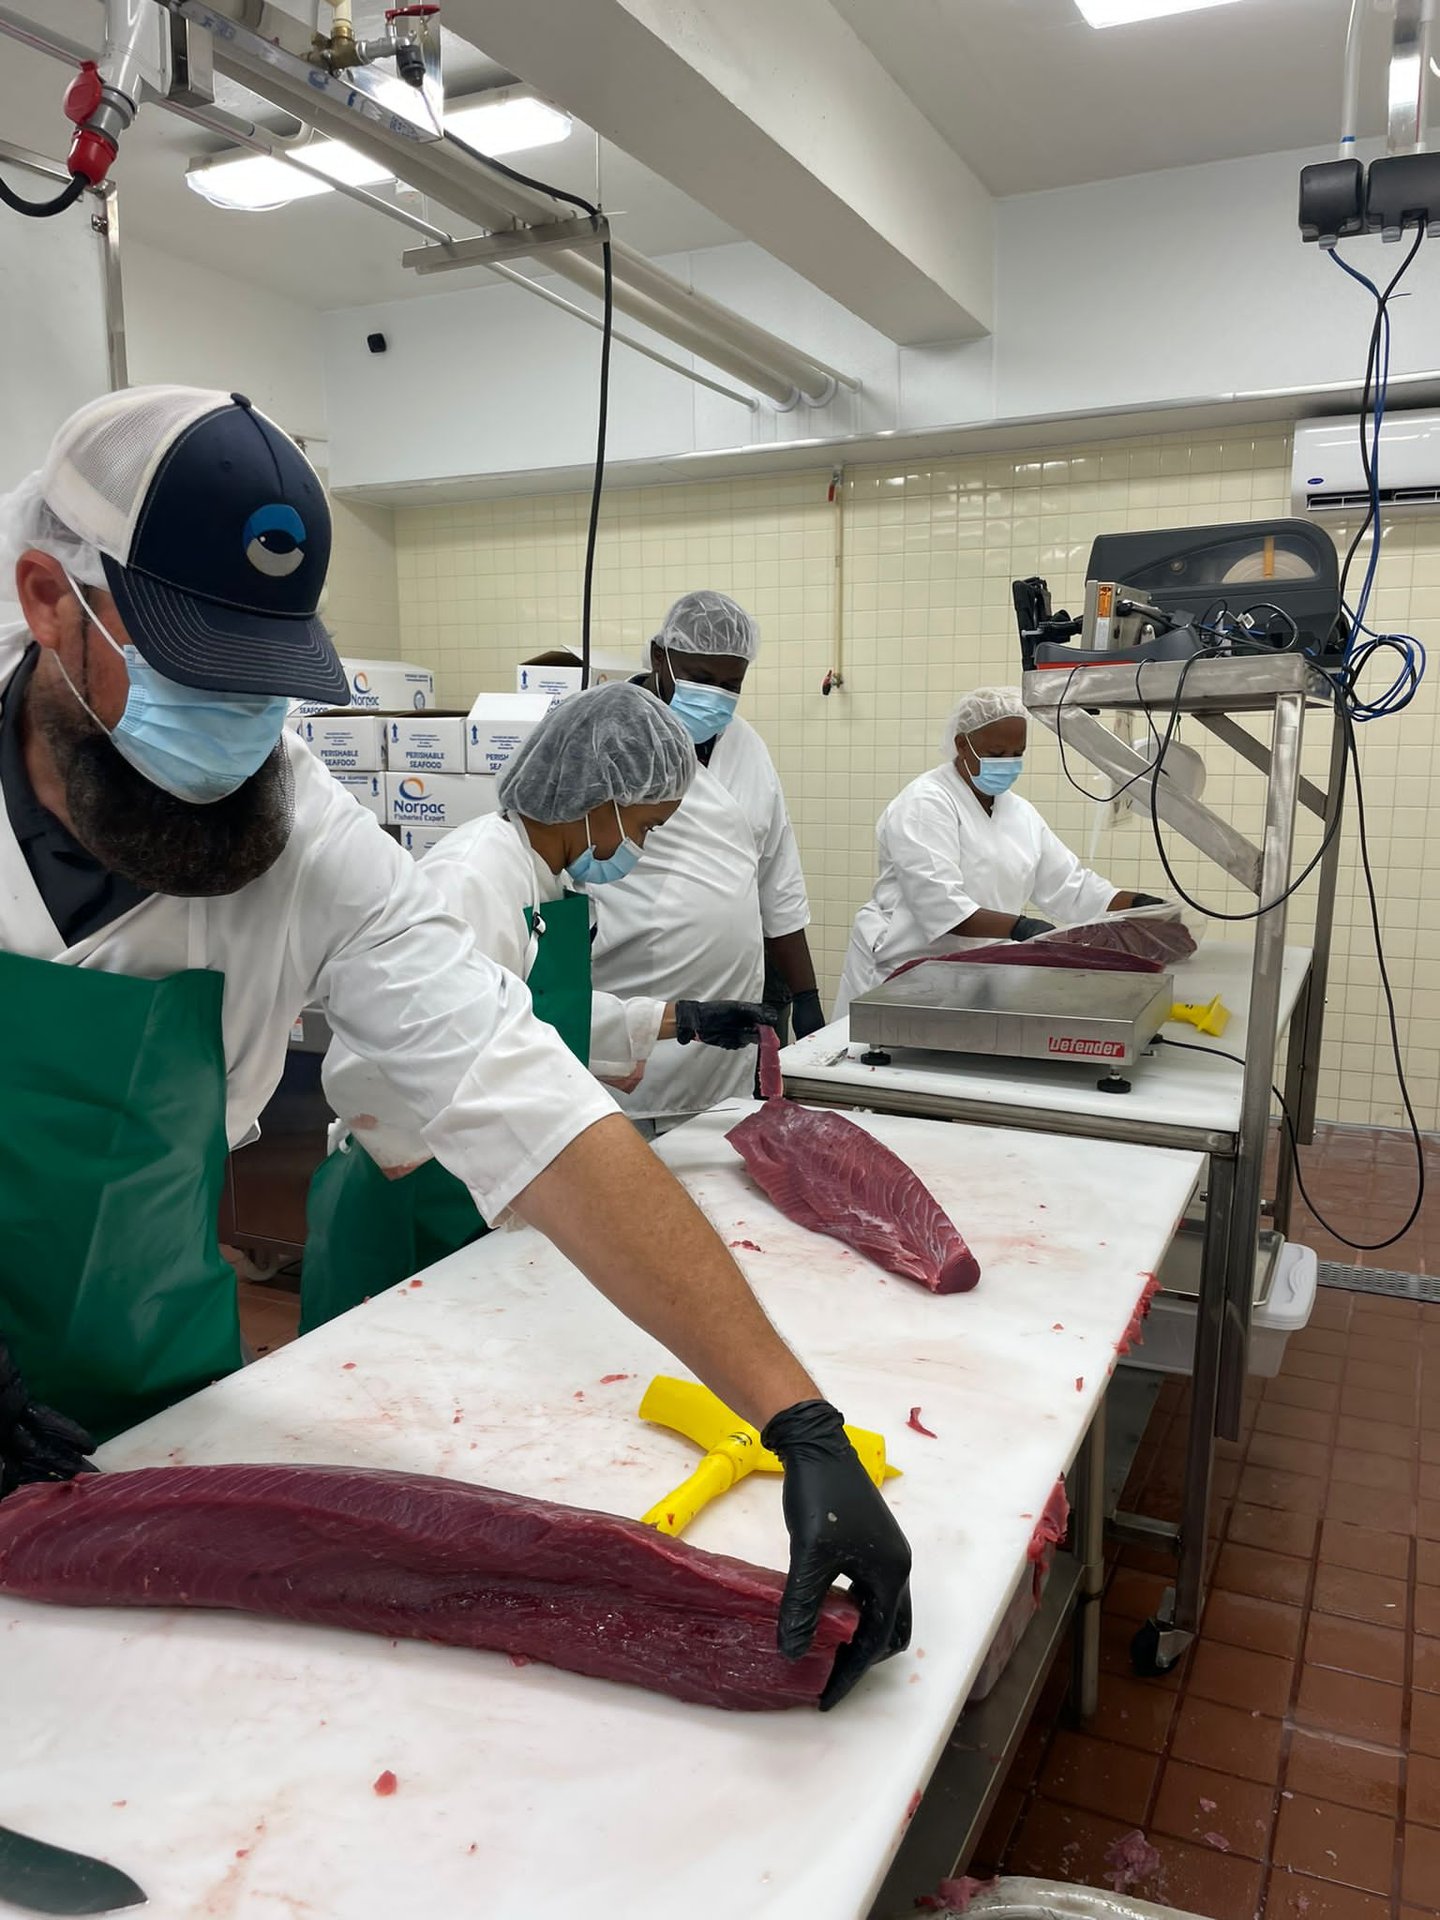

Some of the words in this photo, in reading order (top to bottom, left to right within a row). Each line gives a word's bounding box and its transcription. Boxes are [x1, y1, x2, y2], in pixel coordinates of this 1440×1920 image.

[351, 694, 379, 706] Norpac
[321, 750, 359, 758] PERISHABLE
[406, 752, 445, 760] PERISHABLE
[486, 753, 509, 761] PERISH
[325, 759, 356, 767] SEAFOOD
[410, 761, 442, 769] SEAFOOD
[393, 800, 446, 814] Norpac
[424, 814, 446, 822] Expert
[1050, 1038, 1120, 1055] Defender
